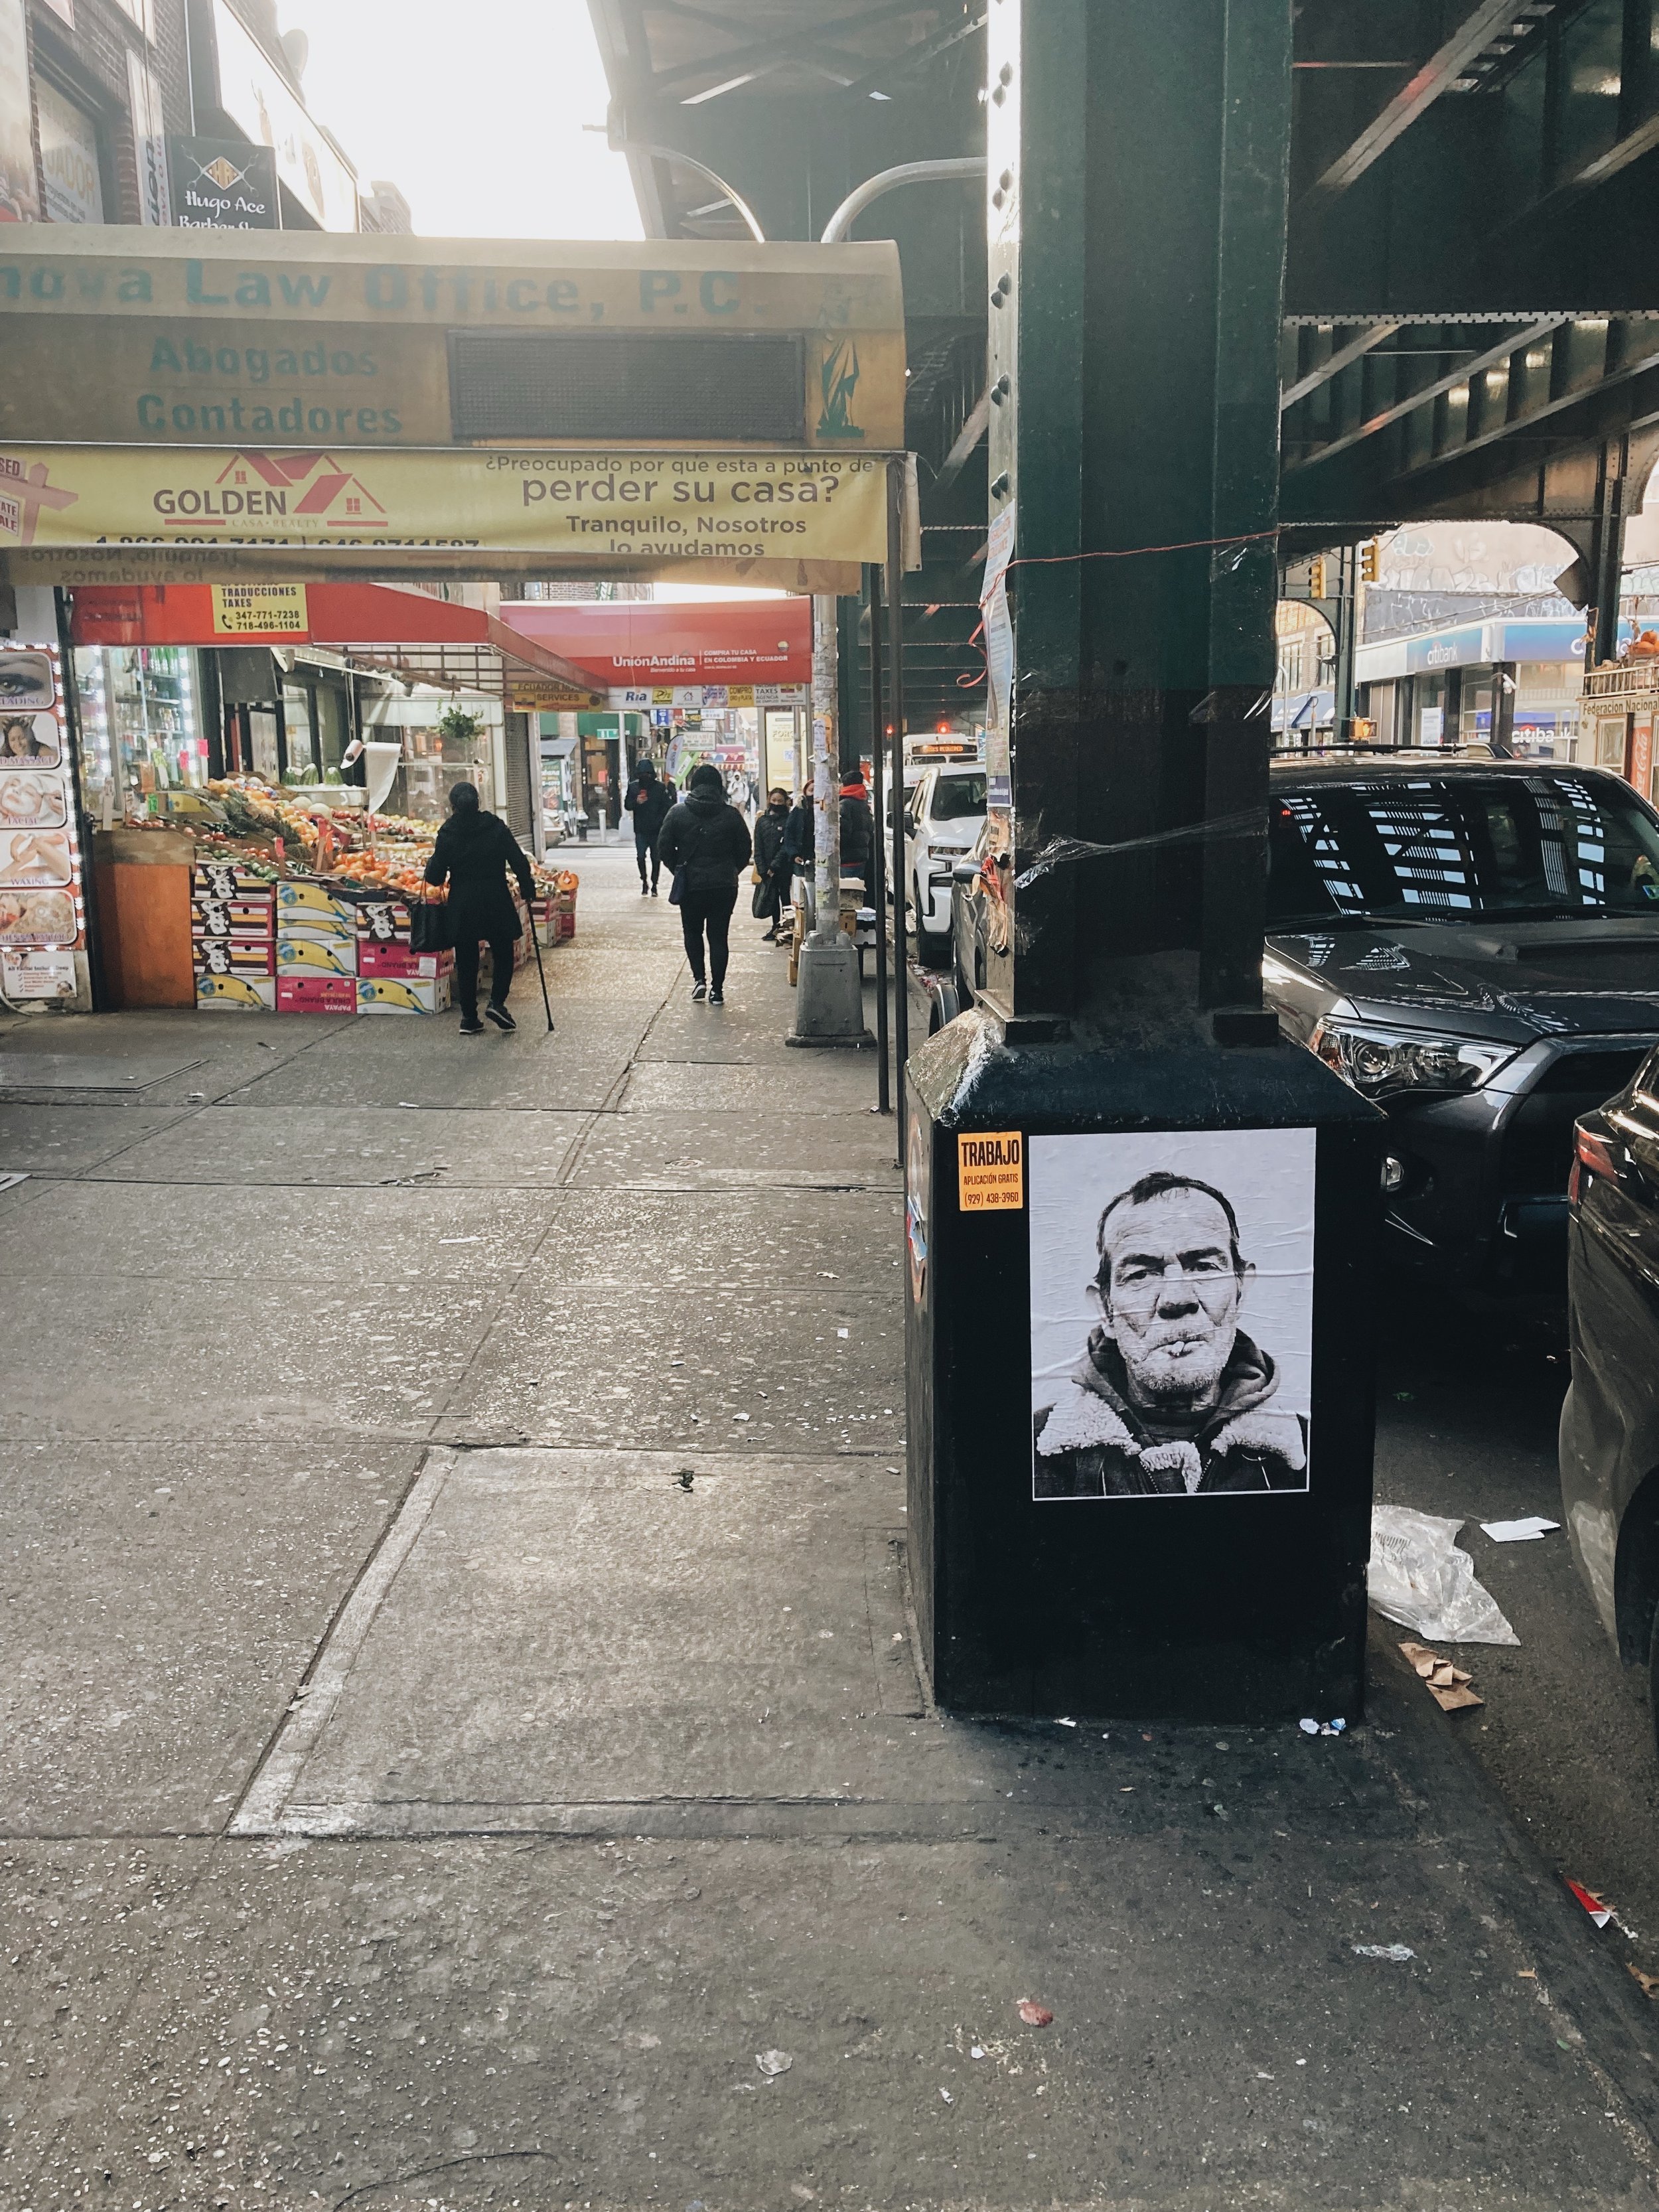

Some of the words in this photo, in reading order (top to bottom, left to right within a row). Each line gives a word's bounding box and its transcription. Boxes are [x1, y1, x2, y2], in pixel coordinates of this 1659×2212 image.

[185, 190, 231, 219] Hugo
[234, 196, 266, 214] Ace
[186, 259, 330, 309] Law
[363, 263, 604, 321] Office,
[638, 269, 766, 316] P.C.
[149, 336, 379, 385] Abogados
[137, 394, 403, 435] Contadores
[486, 456, 622, 477] ¿Preocupado
[630, 461, 664, 477] por
[765, 463, 777, 475] a
[786, 458, 842, 479] punto
[849, 457, 873, 475] de
[523, 474, 658, 508] perder
[672, 482, 715, 503] su
[730, 476, 839, 504] casa?
[153, 489, 287, 515] GOLDEN
[566, 516, 689, 538] Tranquilo,
[697, 516, 807, 534] Nosotros
[610, 540, 632, 553] lo
[222, 587, 297, 597] TRADUCCIONES
[222, 598, 252, 608] TAXES
[236, 610, 300, 620] 347-771-7238
[236, 621, 301, 630] 718-496-1104
[1427, 643, 1459, 666] citibank
[1583, 700, 1623, 715] Federacion
[1626, 698, 1659, 713] Nacional
[1512, 727, 1571, 743] citibak
[8, 817, 38, 826] FACIAL
[961, 1140, 1020, 1167] TRABAJO
[964, 1172, 997, 1185] APLICACIÓN
[998, 1173, 1019, 1184] GRATIS
[964, 1191, 983, 1207] (929)
[986, 1192, 1019, 1203] 438-3960
